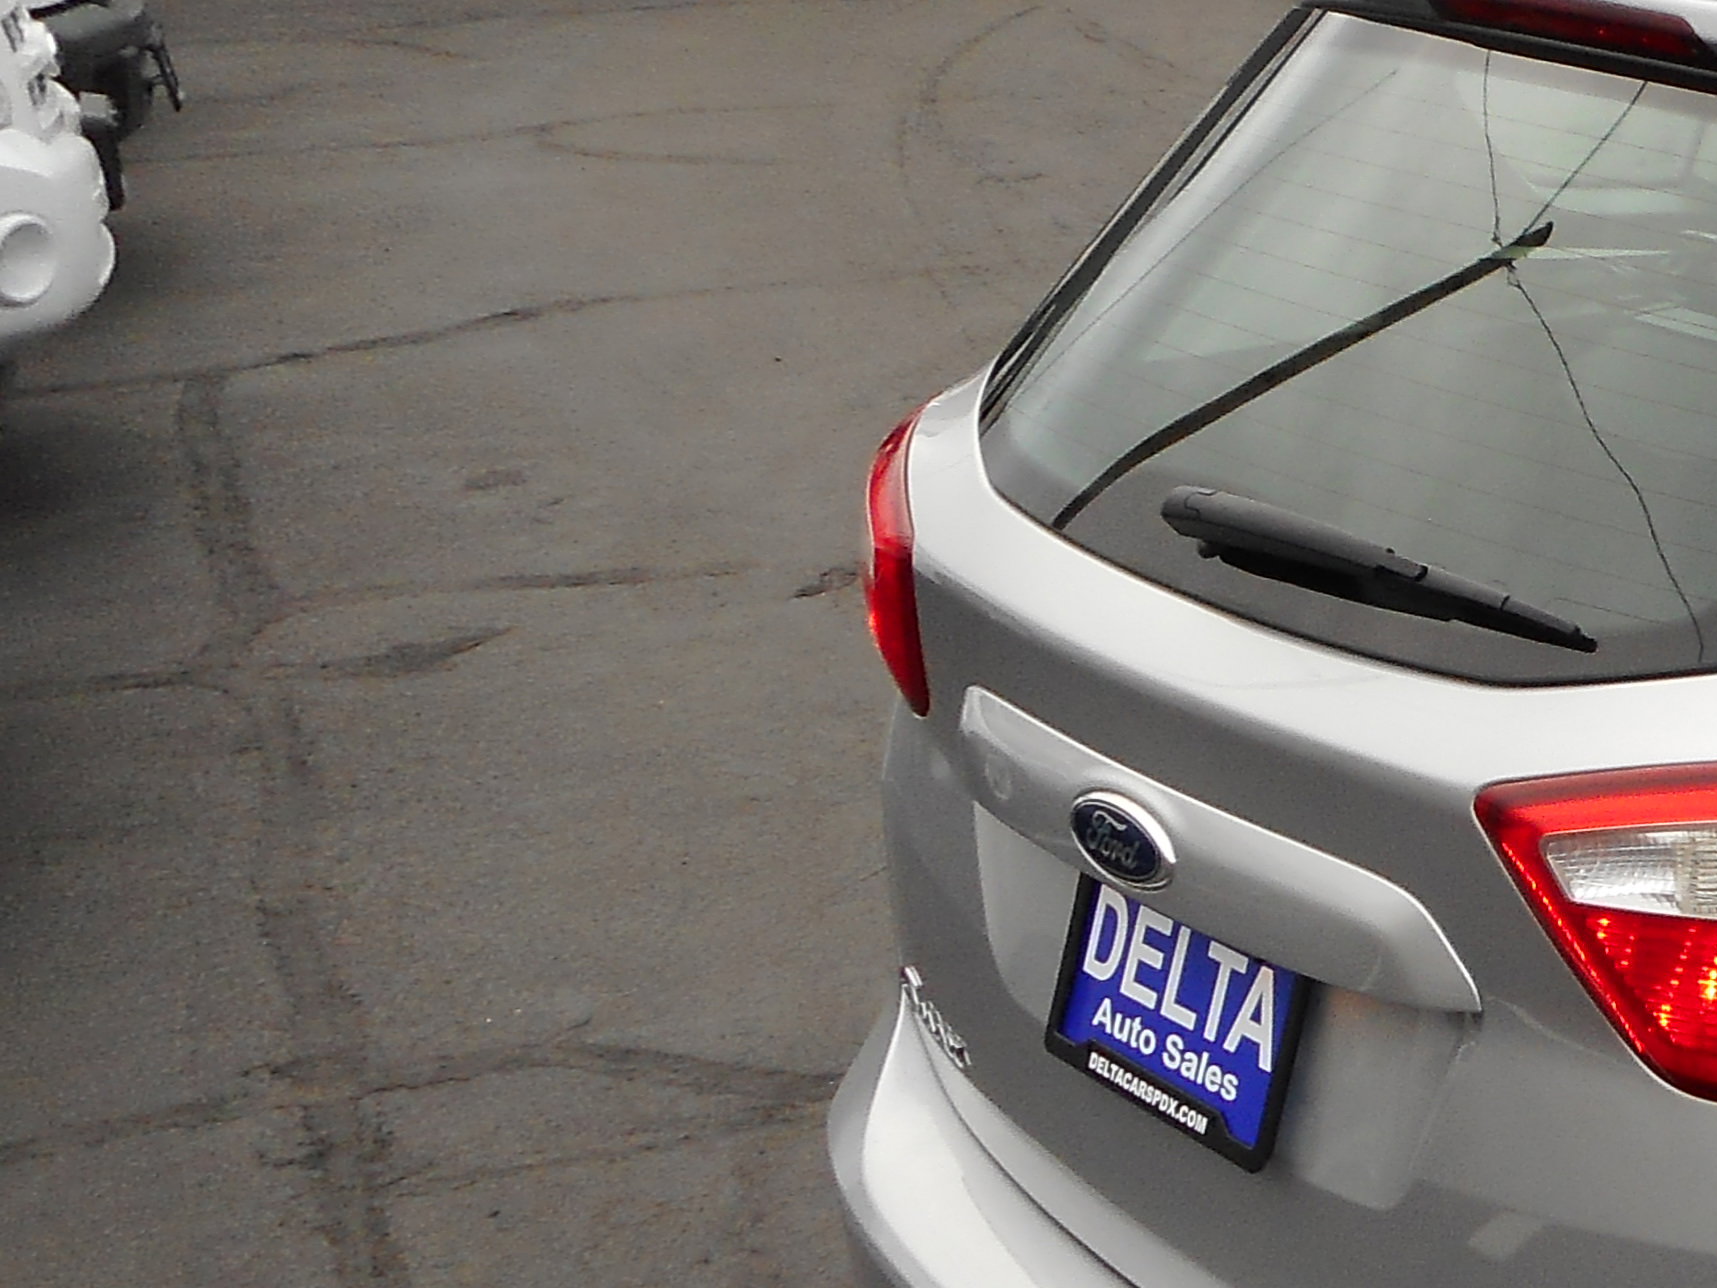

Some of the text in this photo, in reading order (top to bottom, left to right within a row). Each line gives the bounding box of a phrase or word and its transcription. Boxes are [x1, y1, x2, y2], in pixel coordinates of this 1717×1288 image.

[1085, 809, 1138, 870] Ford
[1082, 883, 1275, 1073] DELTA
[1087, 1050, 1209, 1135] DELTACARSPDX.COM
[1091, 997, 1239, 1101] Auto Sales
